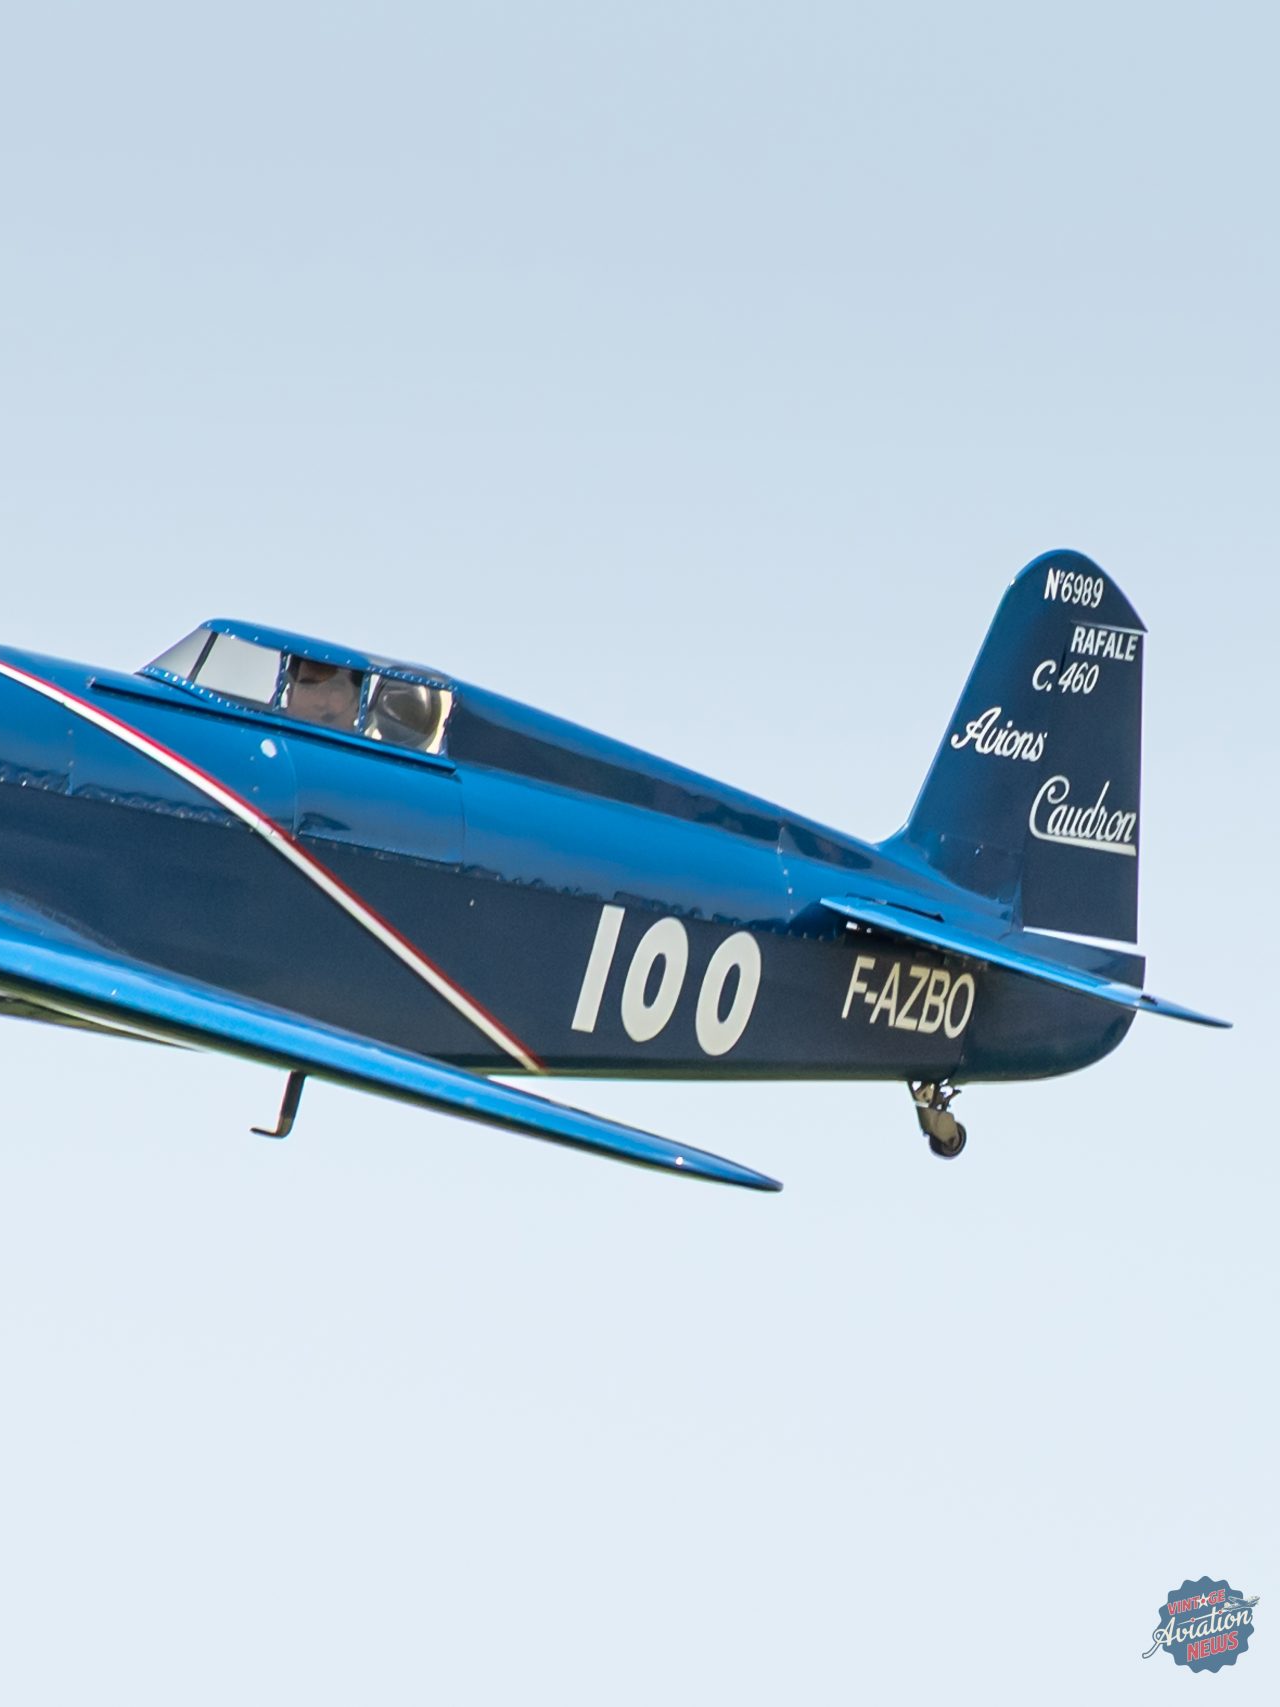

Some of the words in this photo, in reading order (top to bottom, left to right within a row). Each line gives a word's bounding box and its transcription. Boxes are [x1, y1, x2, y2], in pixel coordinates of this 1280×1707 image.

[1058, 661, 1100, 694] 460
[1070, 625, 1139, 661] RAFALE
[950, 706, 1048, 762] Avions
[1028, 774, 1137, 856] Caudron
[571, 904, 762, 1056] 100
[841, 955, 976, 1039] F-AZBO
